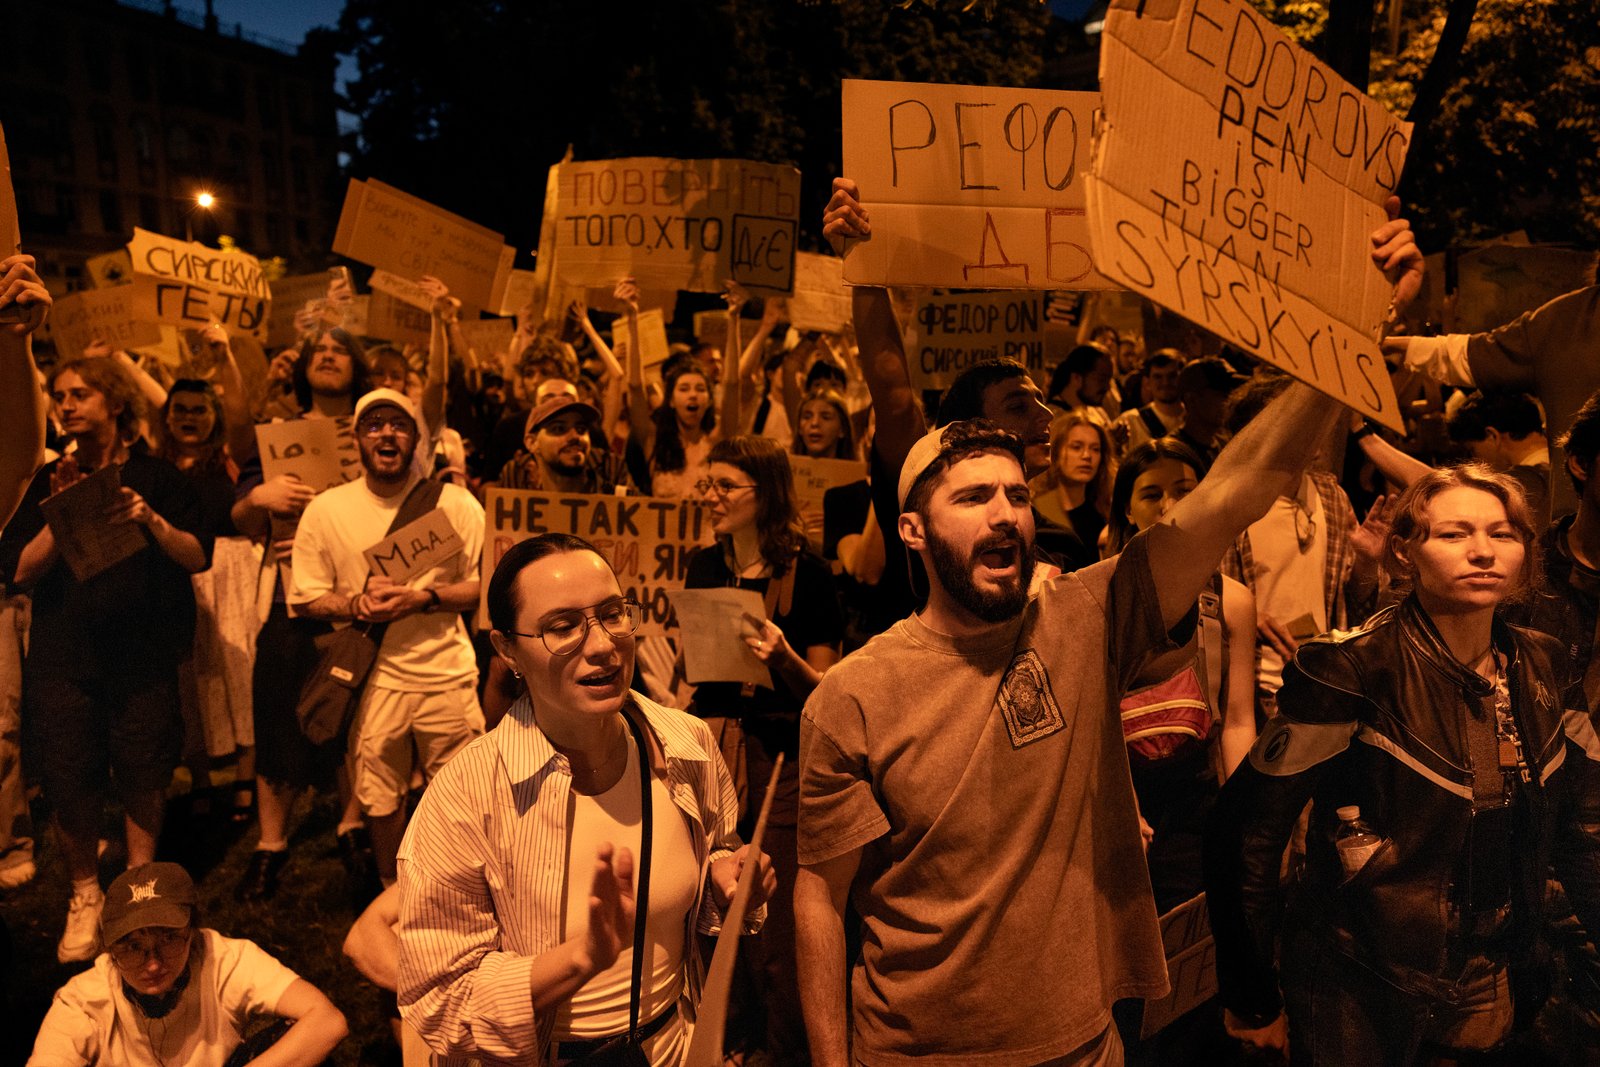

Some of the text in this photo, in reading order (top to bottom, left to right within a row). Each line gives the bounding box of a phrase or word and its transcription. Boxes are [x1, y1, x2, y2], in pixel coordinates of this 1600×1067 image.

[1136, 0, 1408, 192] EDOROV'S
[1218, 84, 1311, 184] PEN
[889, 99, 1100, 191] РЕФО
[572, 167, 797, 217] ПОВЕРНІТЬ
[1150, 189, 1282, 304] THAN
[919, 302, 999, 335] ФЕДОР
[494, 496, 550, 533] НЕ
[560, 498, 640, 537] ТАК
